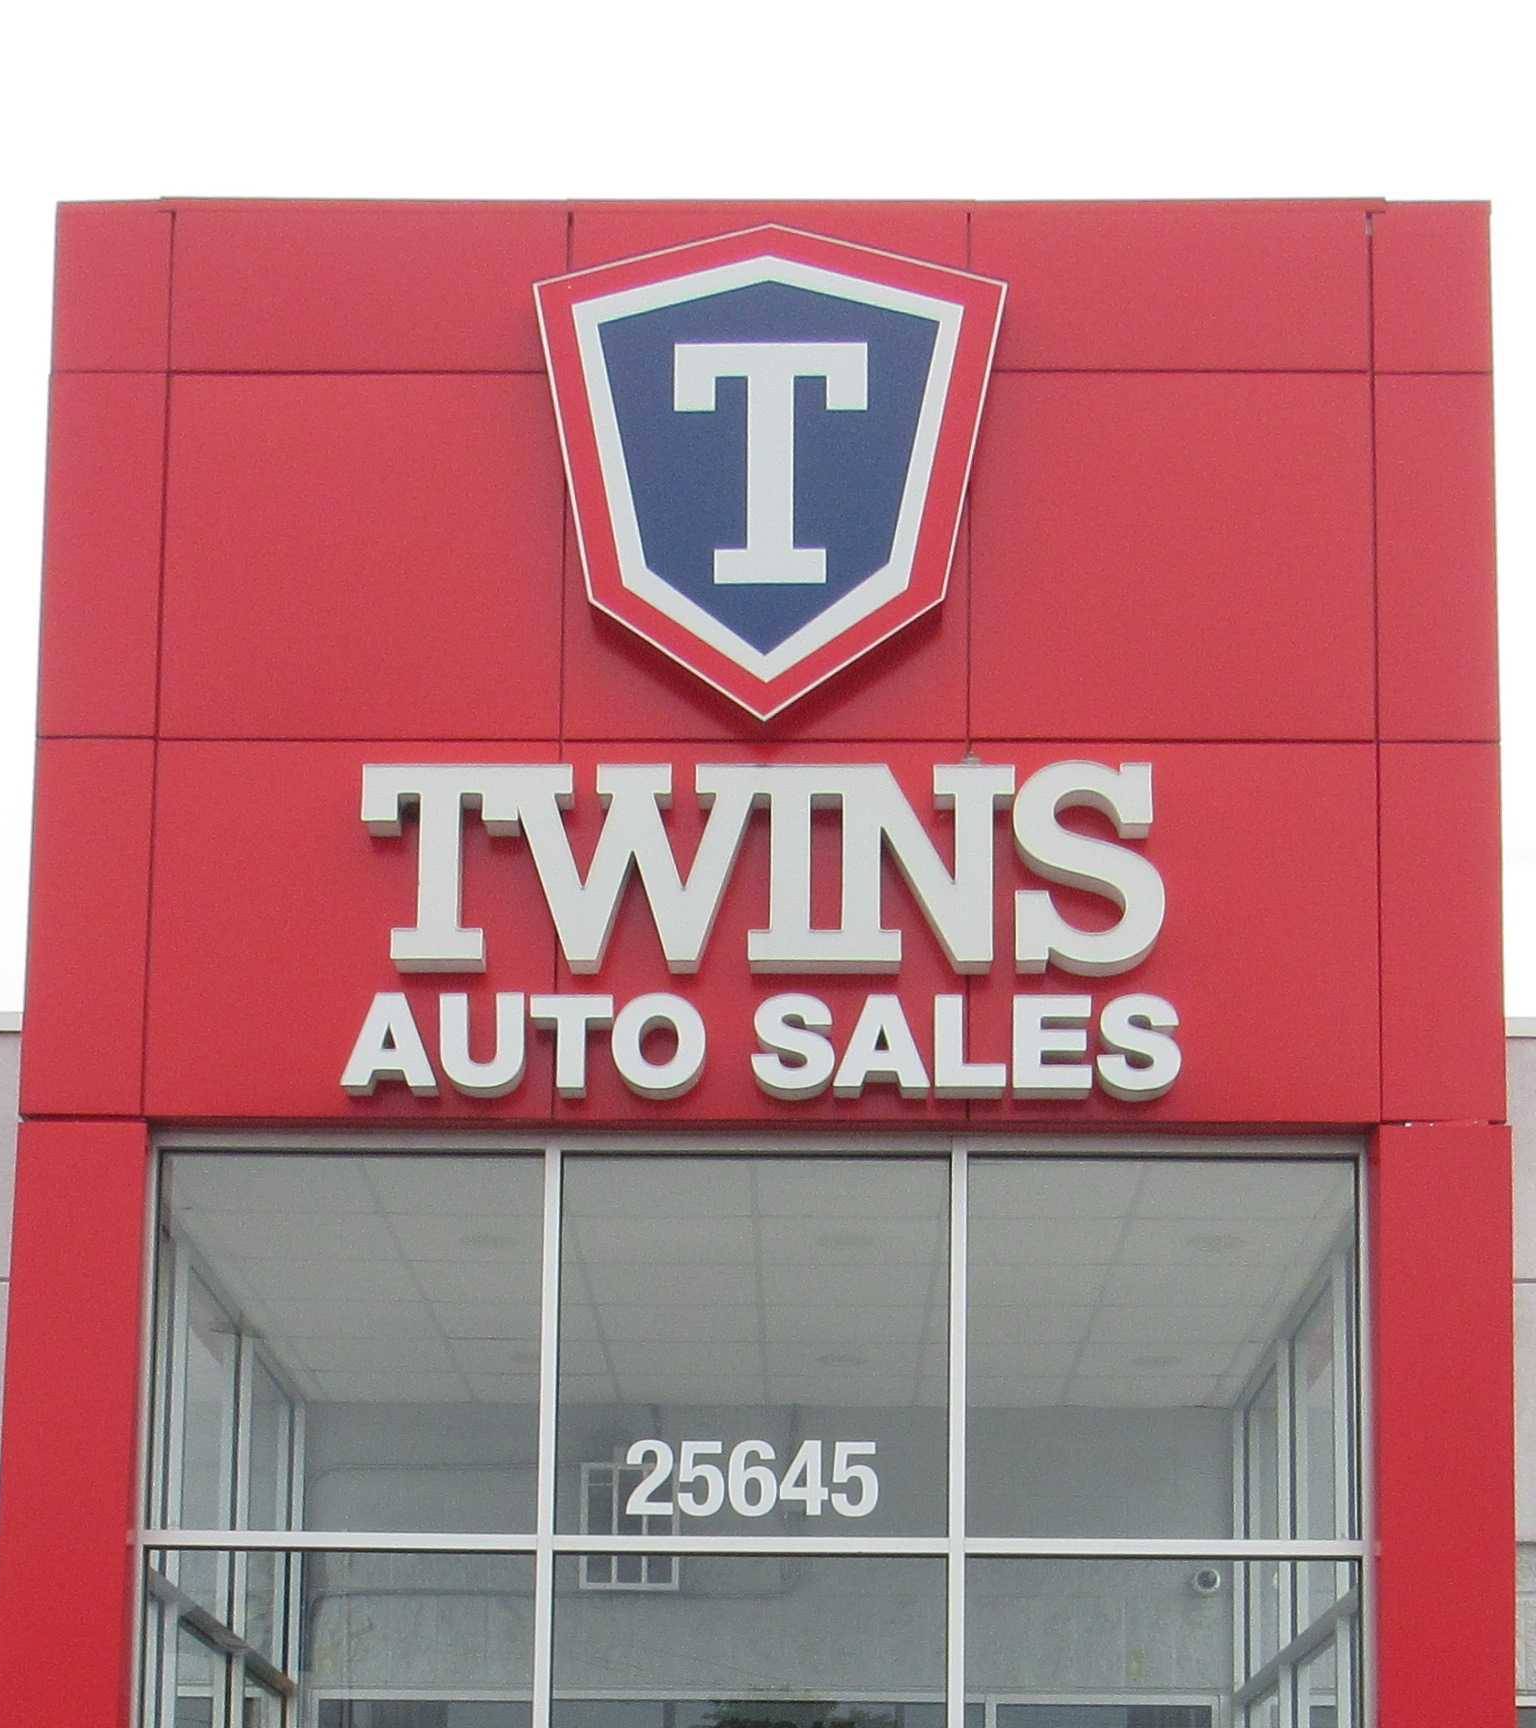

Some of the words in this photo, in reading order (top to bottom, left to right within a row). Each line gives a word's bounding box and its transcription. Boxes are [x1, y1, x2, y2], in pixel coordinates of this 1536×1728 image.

[673, 341, 868, 585] T
[361, 759, 1166, 979] TWINS
[340, 991, 707, 1099] AUTO
[750, 992, 1182, 1104] SALES
[624, 1438, 880, 1518] 25645
